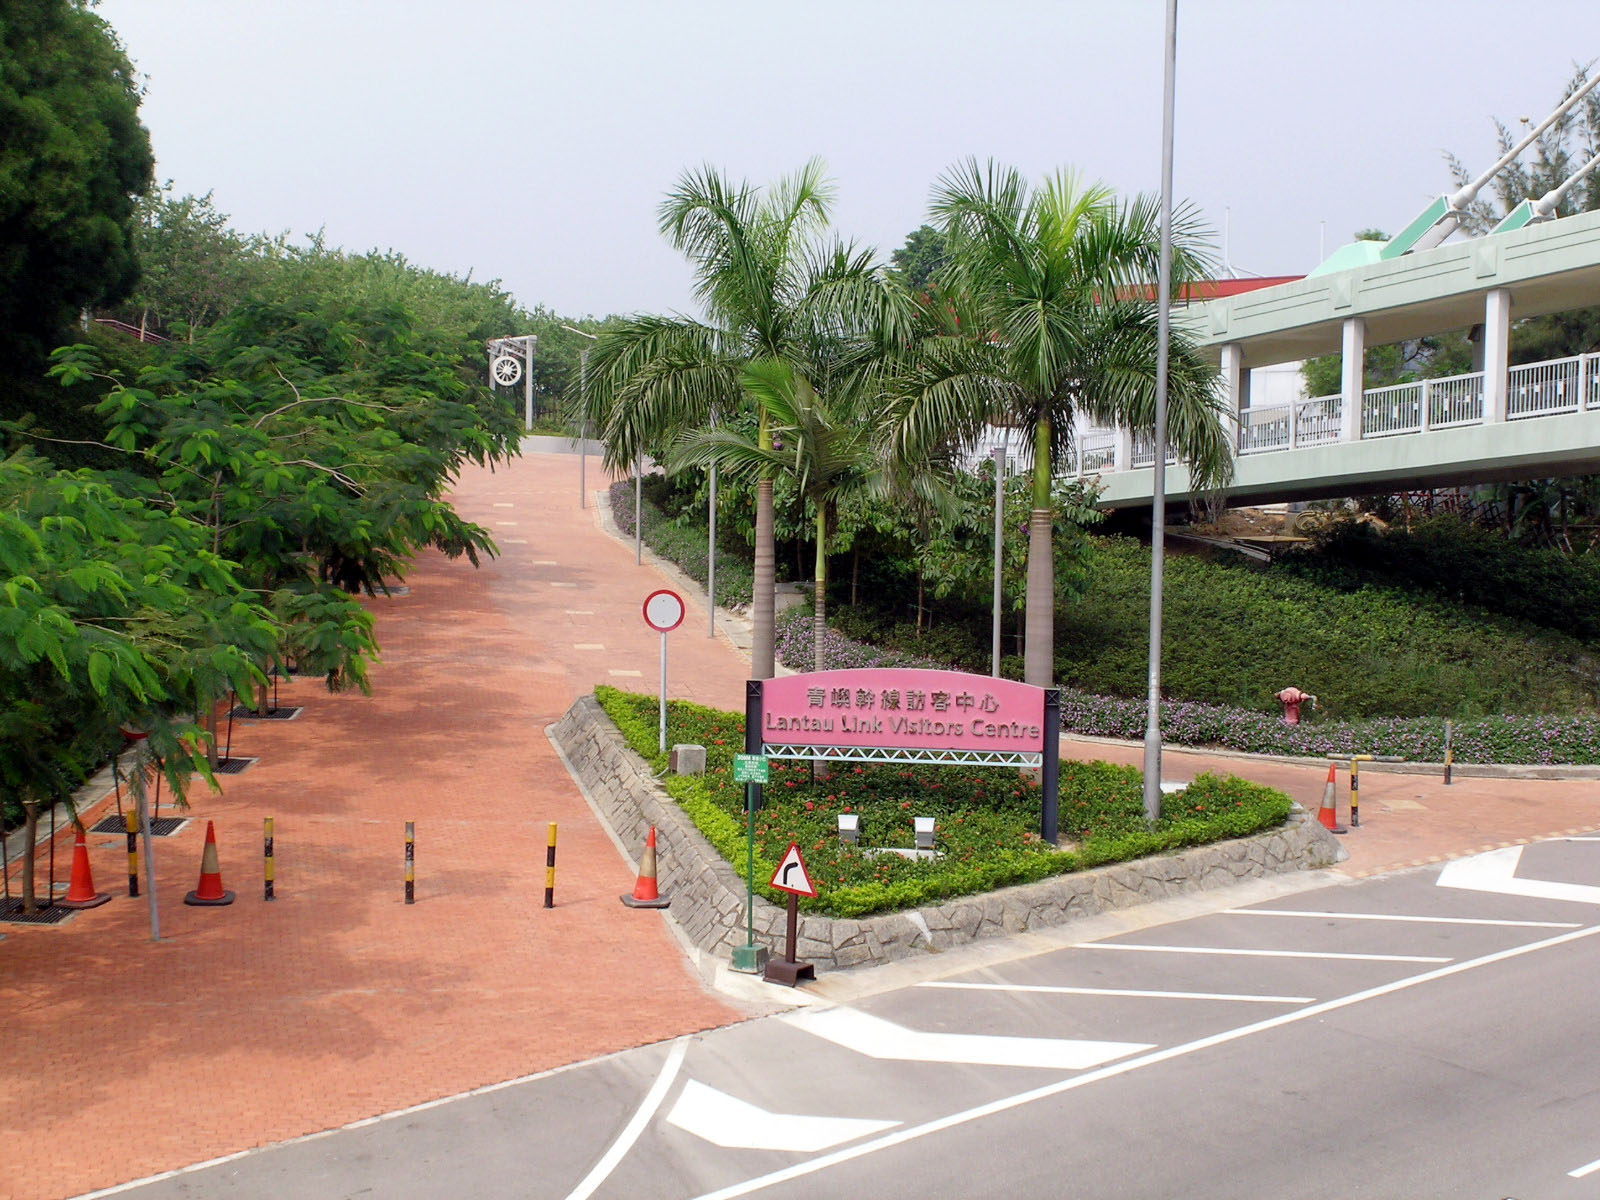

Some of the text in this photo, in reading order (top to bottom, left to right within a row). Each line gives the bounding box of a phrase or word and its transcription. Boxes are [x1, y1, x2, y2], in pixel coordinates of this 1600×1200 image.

[807, 687, 1000, 713] 青嶼幹線訪客中心
[766, 712, 1040, 738] Lantau Link Visitors Centre
